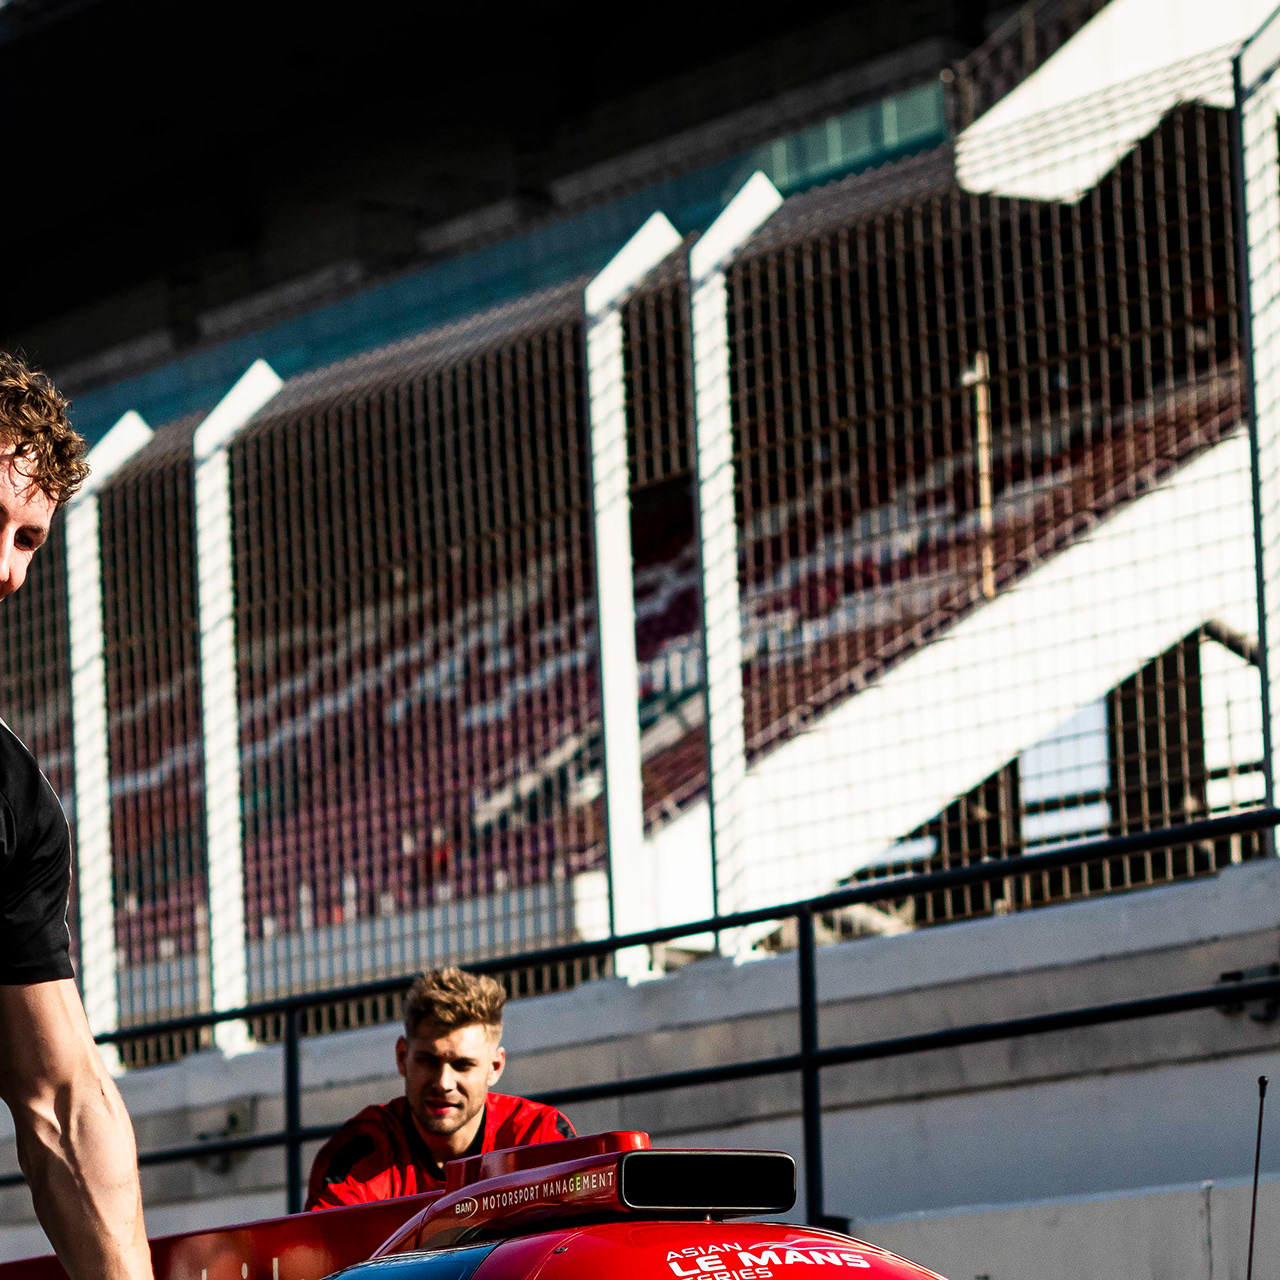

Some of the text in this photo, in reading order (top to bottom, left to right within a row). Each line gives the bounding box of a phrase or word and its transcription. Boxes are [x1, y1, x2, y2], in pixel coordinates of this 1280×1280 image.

[455, 1171, 614, 1215] BAM MOTORSPORT MANAGEMENT
[666, 1242, 743, 1261] ASIAN
[669, 1250, 870, 1277] LE MANS
